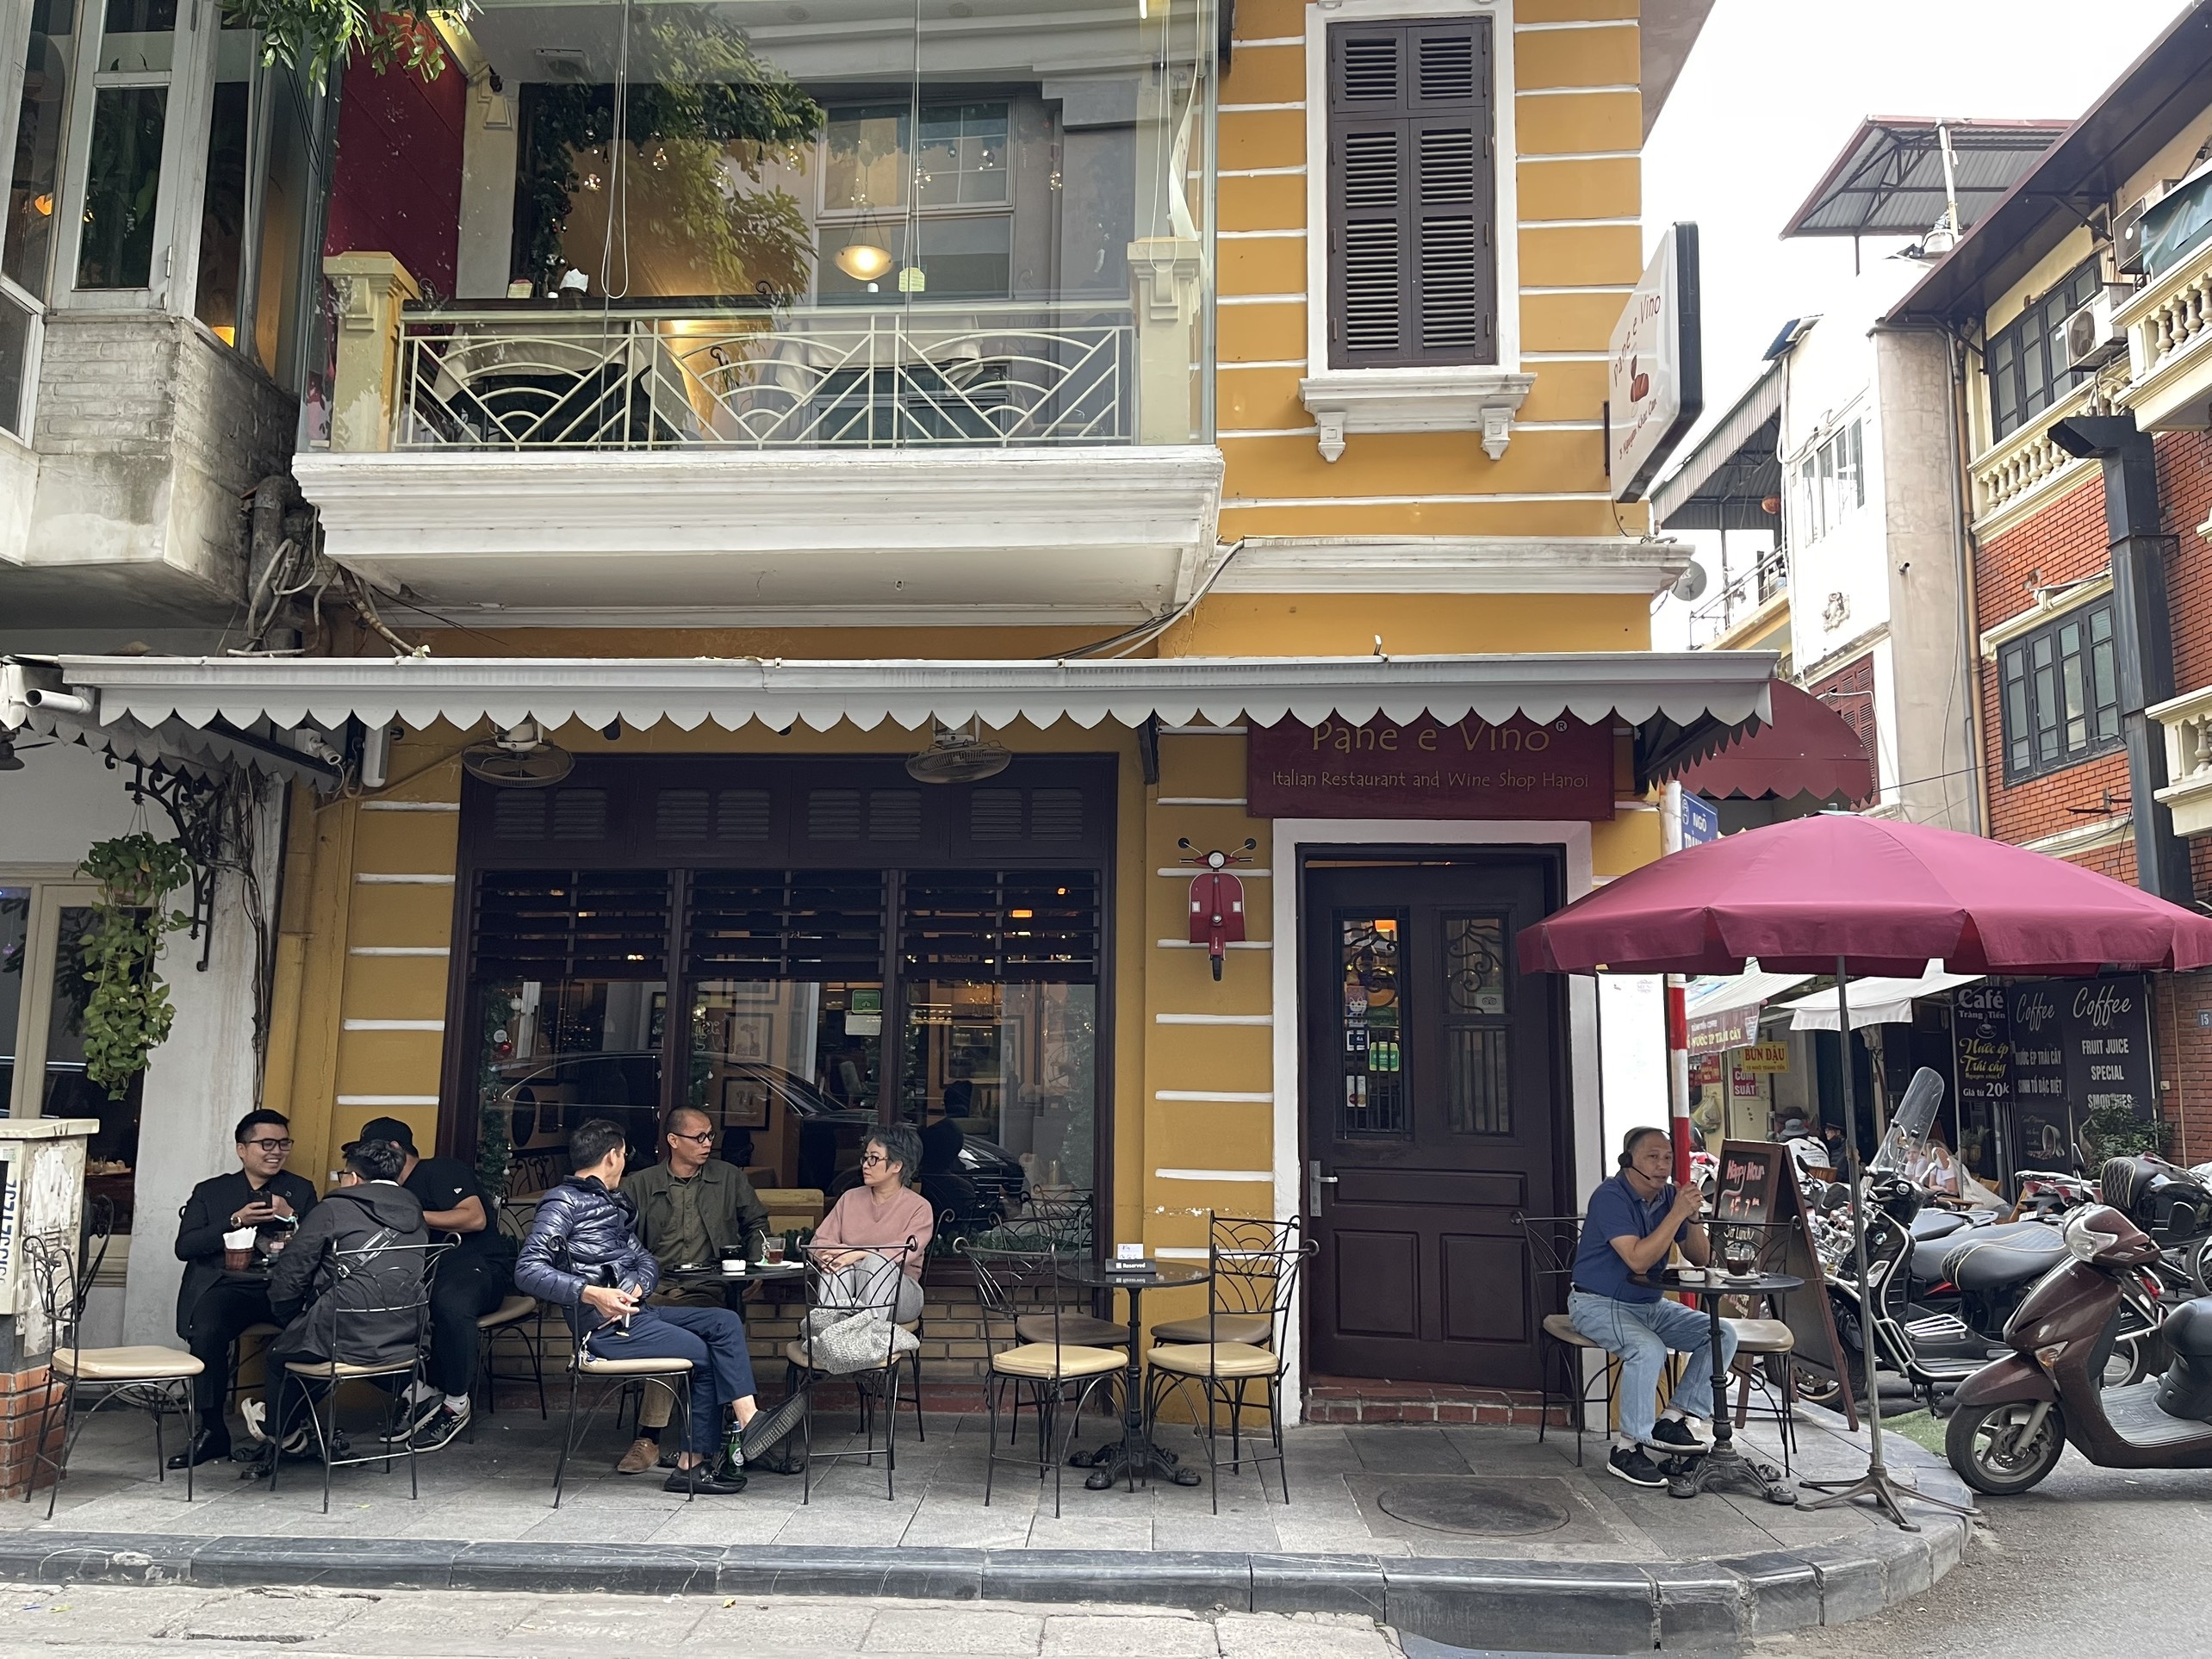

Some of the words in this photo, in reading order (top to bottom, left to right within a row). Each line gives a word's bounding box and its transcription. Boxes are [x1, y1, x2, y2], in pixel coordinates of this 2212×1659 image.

[1640, 294, 1661, 324] Vino
[1312, 720, 1399, 754] Pane
[1419, 727, 1438, 751] e
[1272, 770, 1316, 787] Italian
[1321, 770, 1406, 787] Restaurant
[1413, 772, 1439, 788] and
[1448, 772, 1490, 787] Wine
[1499, 772, 1536, 791] Shop
[1542, 772, 1589, 789] Hanoi
[1693, 812, 1707, 832] NGÕ
[1958, 988, 2004, 1009] Café
[2072, 985, 2132, 1028] Coffee
[2016, 991, 2055, 1032] Coffee
[2201, 1013, 2209, 1026] 15
[2050, 1047, 2061, 1065] CÂY
[2081, 1040, 2104, 1055] FRUIT
[2105, 1038, 2129, 1054] JUICE
[2091, 1065, 2124, 1081] SPECIAL
[1963, 1087, 1975, 1097] Giá
[1746, 1161, 1765, 1181] Hour
